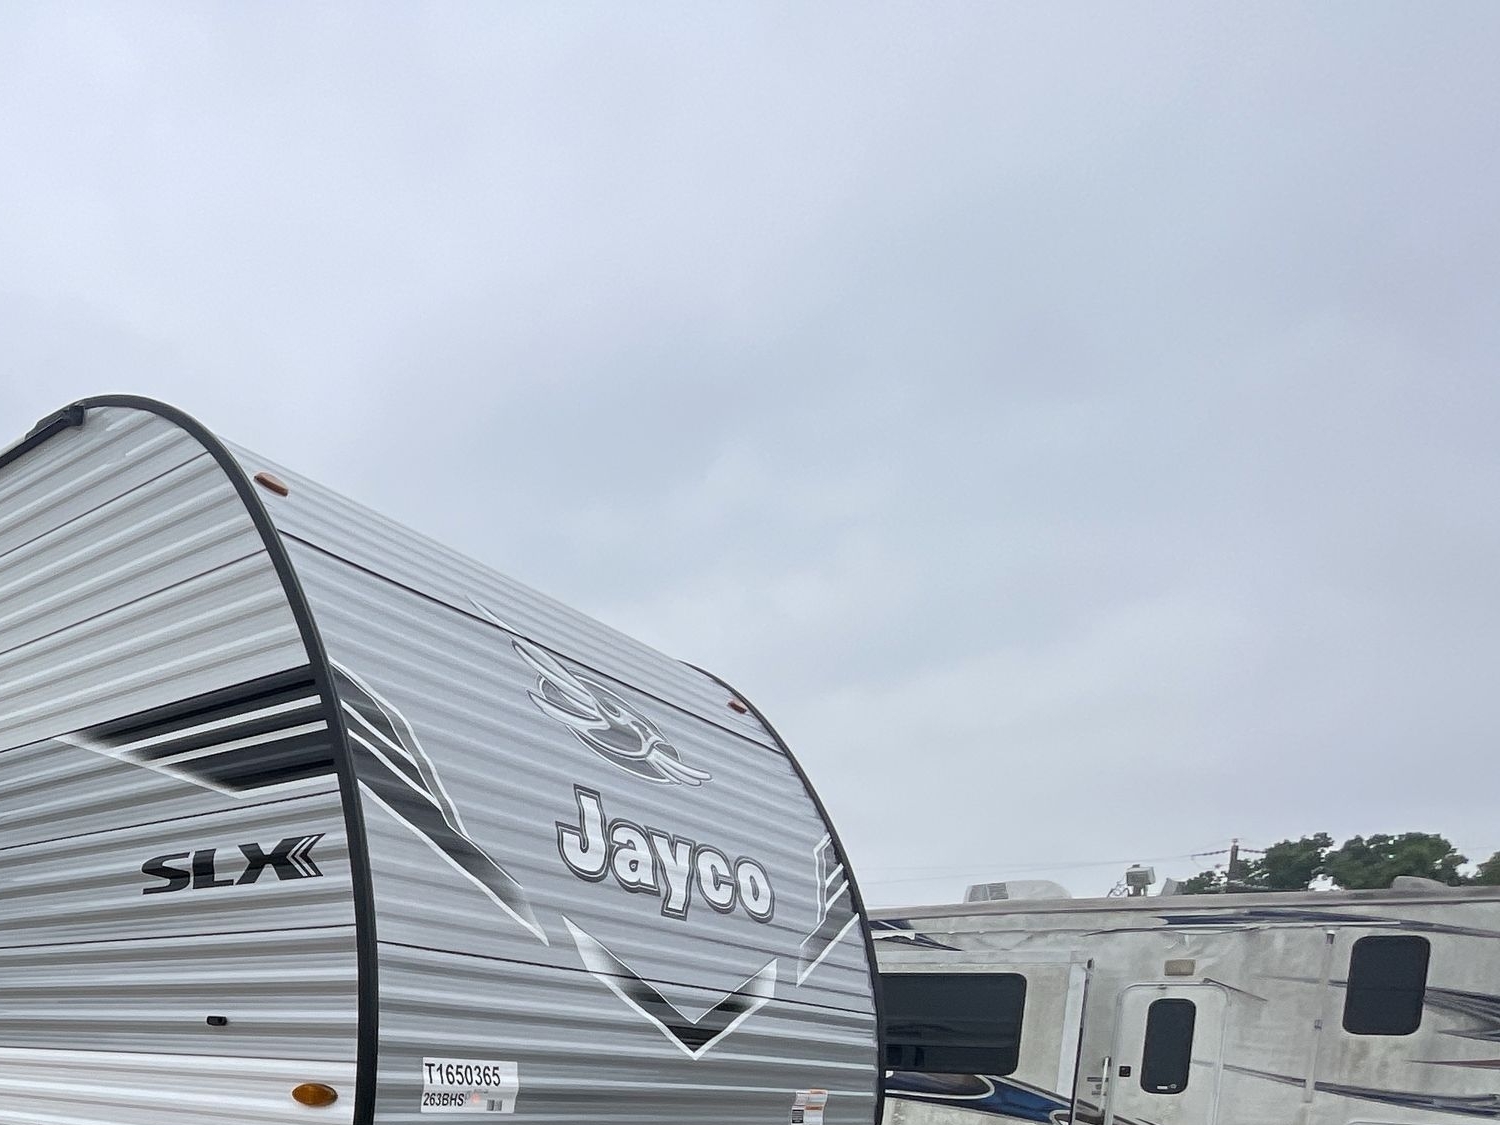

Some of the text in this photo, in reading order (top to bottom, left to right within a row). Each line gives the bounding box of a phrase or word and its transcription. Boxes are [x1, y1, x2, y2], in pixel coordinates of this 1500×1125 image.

[141, 833, 326, 895] SLX
[555, 783, 775, 924] Jayco
[425, 1063, 500, 1086] T1650365
[423, 1093, 465, 1107] 263BHS
